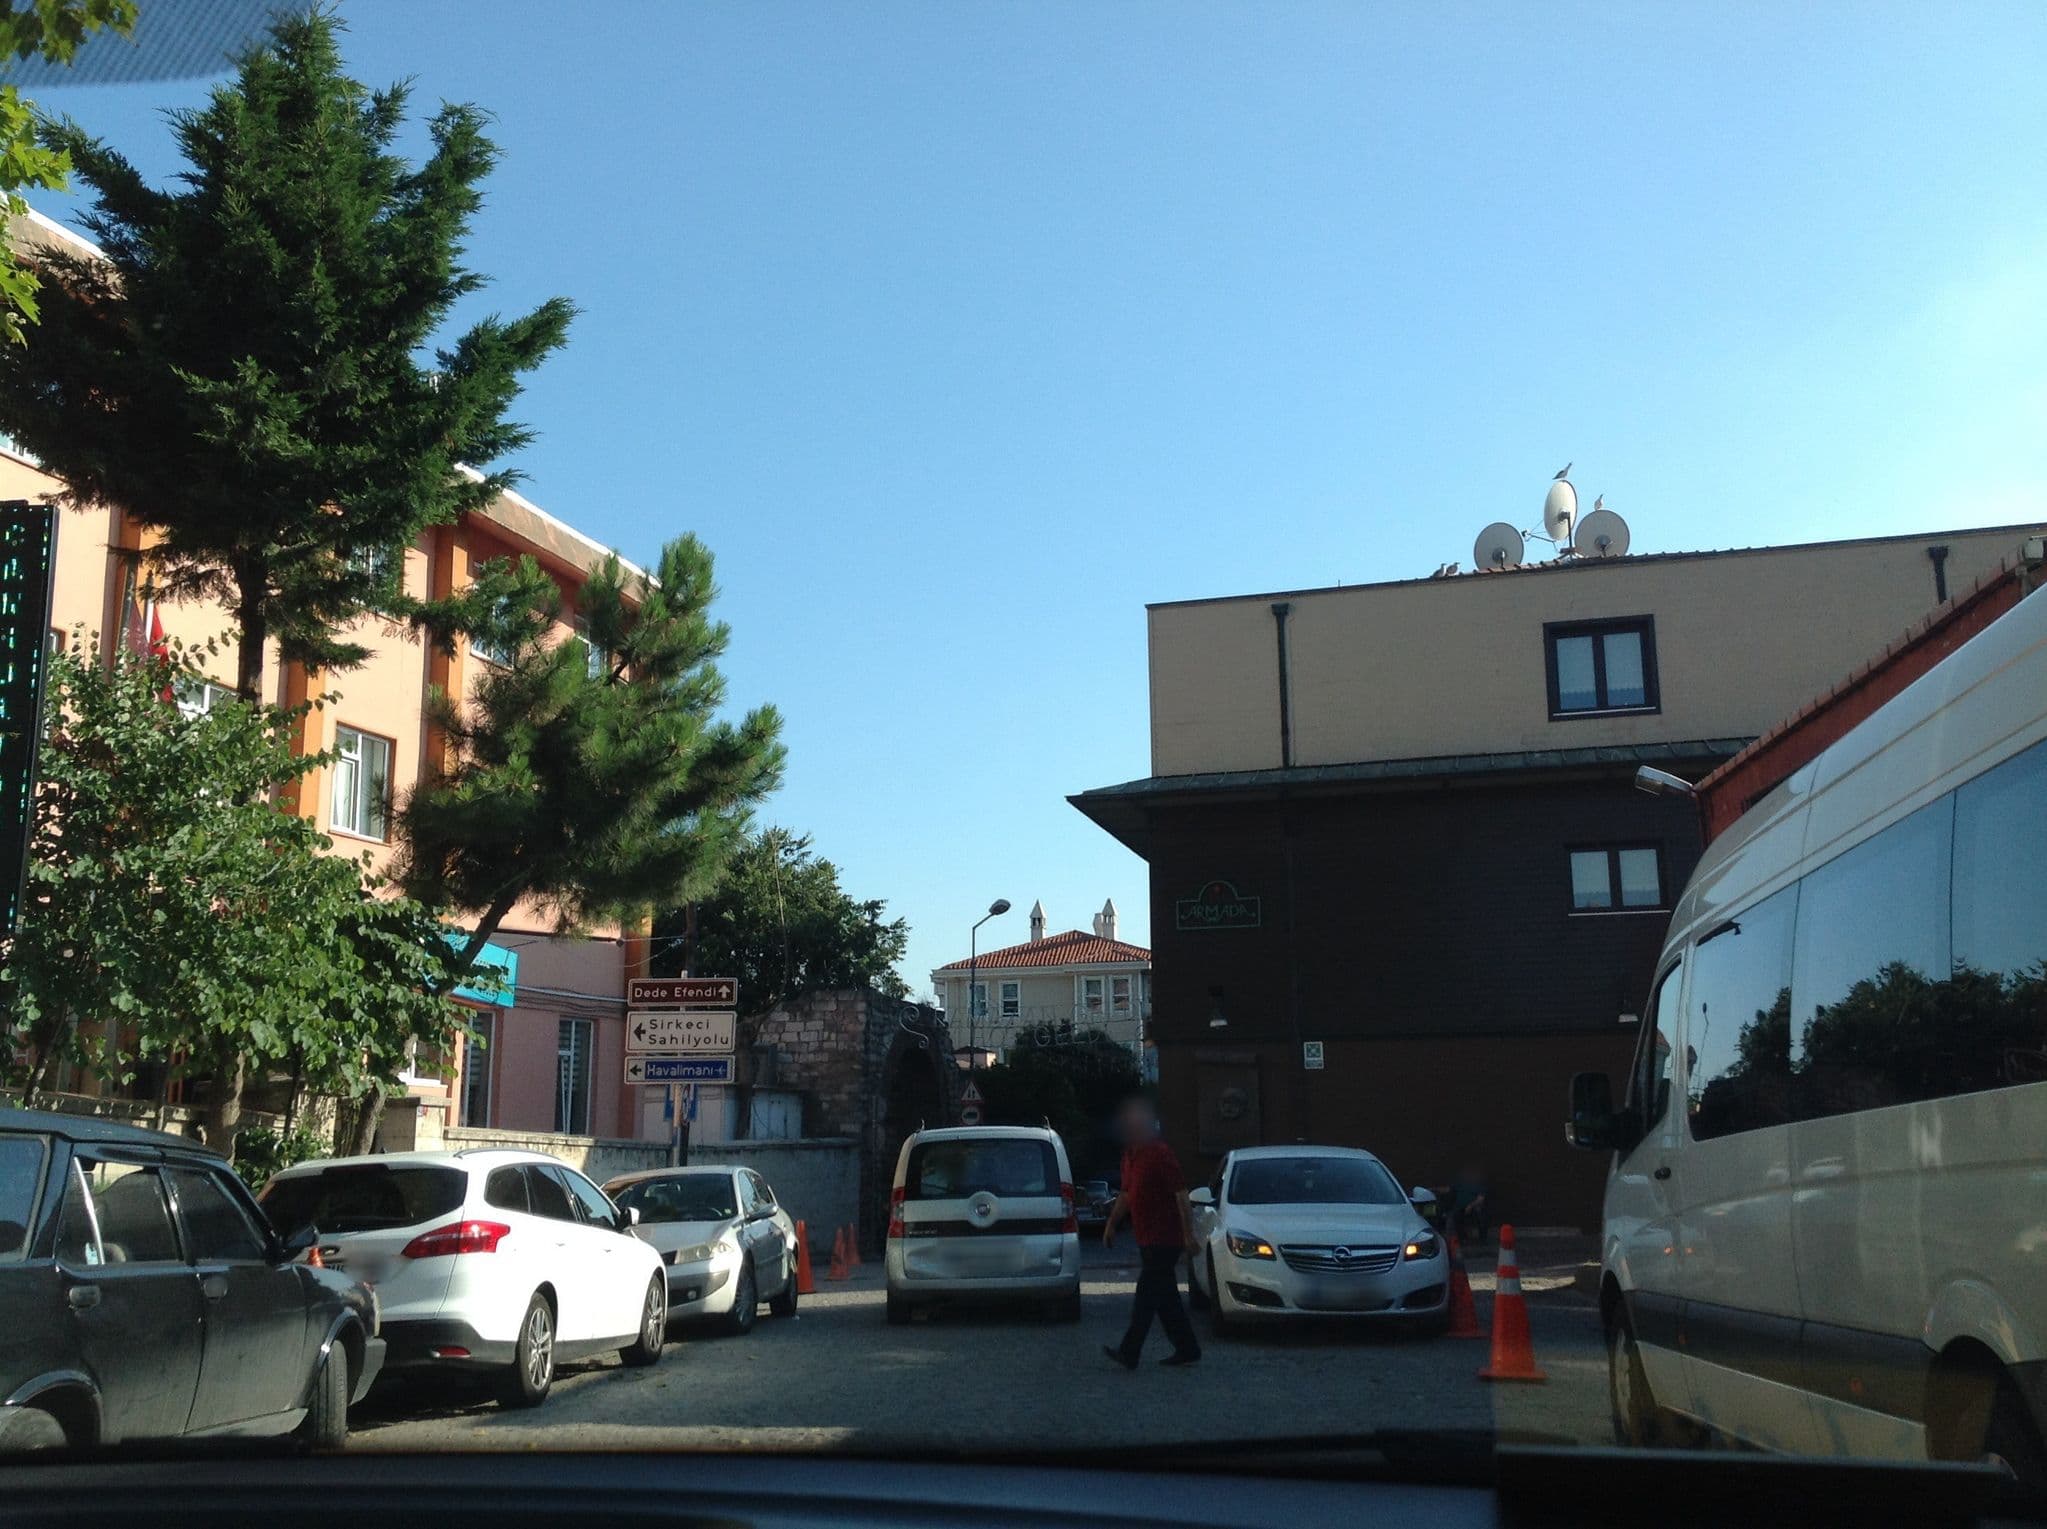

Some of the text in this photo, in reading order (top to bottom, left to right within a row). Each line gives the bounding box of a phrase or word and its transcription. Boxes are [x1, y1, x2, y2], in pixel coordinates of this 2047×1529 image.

[1181, 904, 1257, 922] ARMADA
[634, 986, 716, 998] Dede Efendi
[649, 1019, 710, 1030] Sirkeci
[648, 1034, 729, 1048] Sahilyolu
